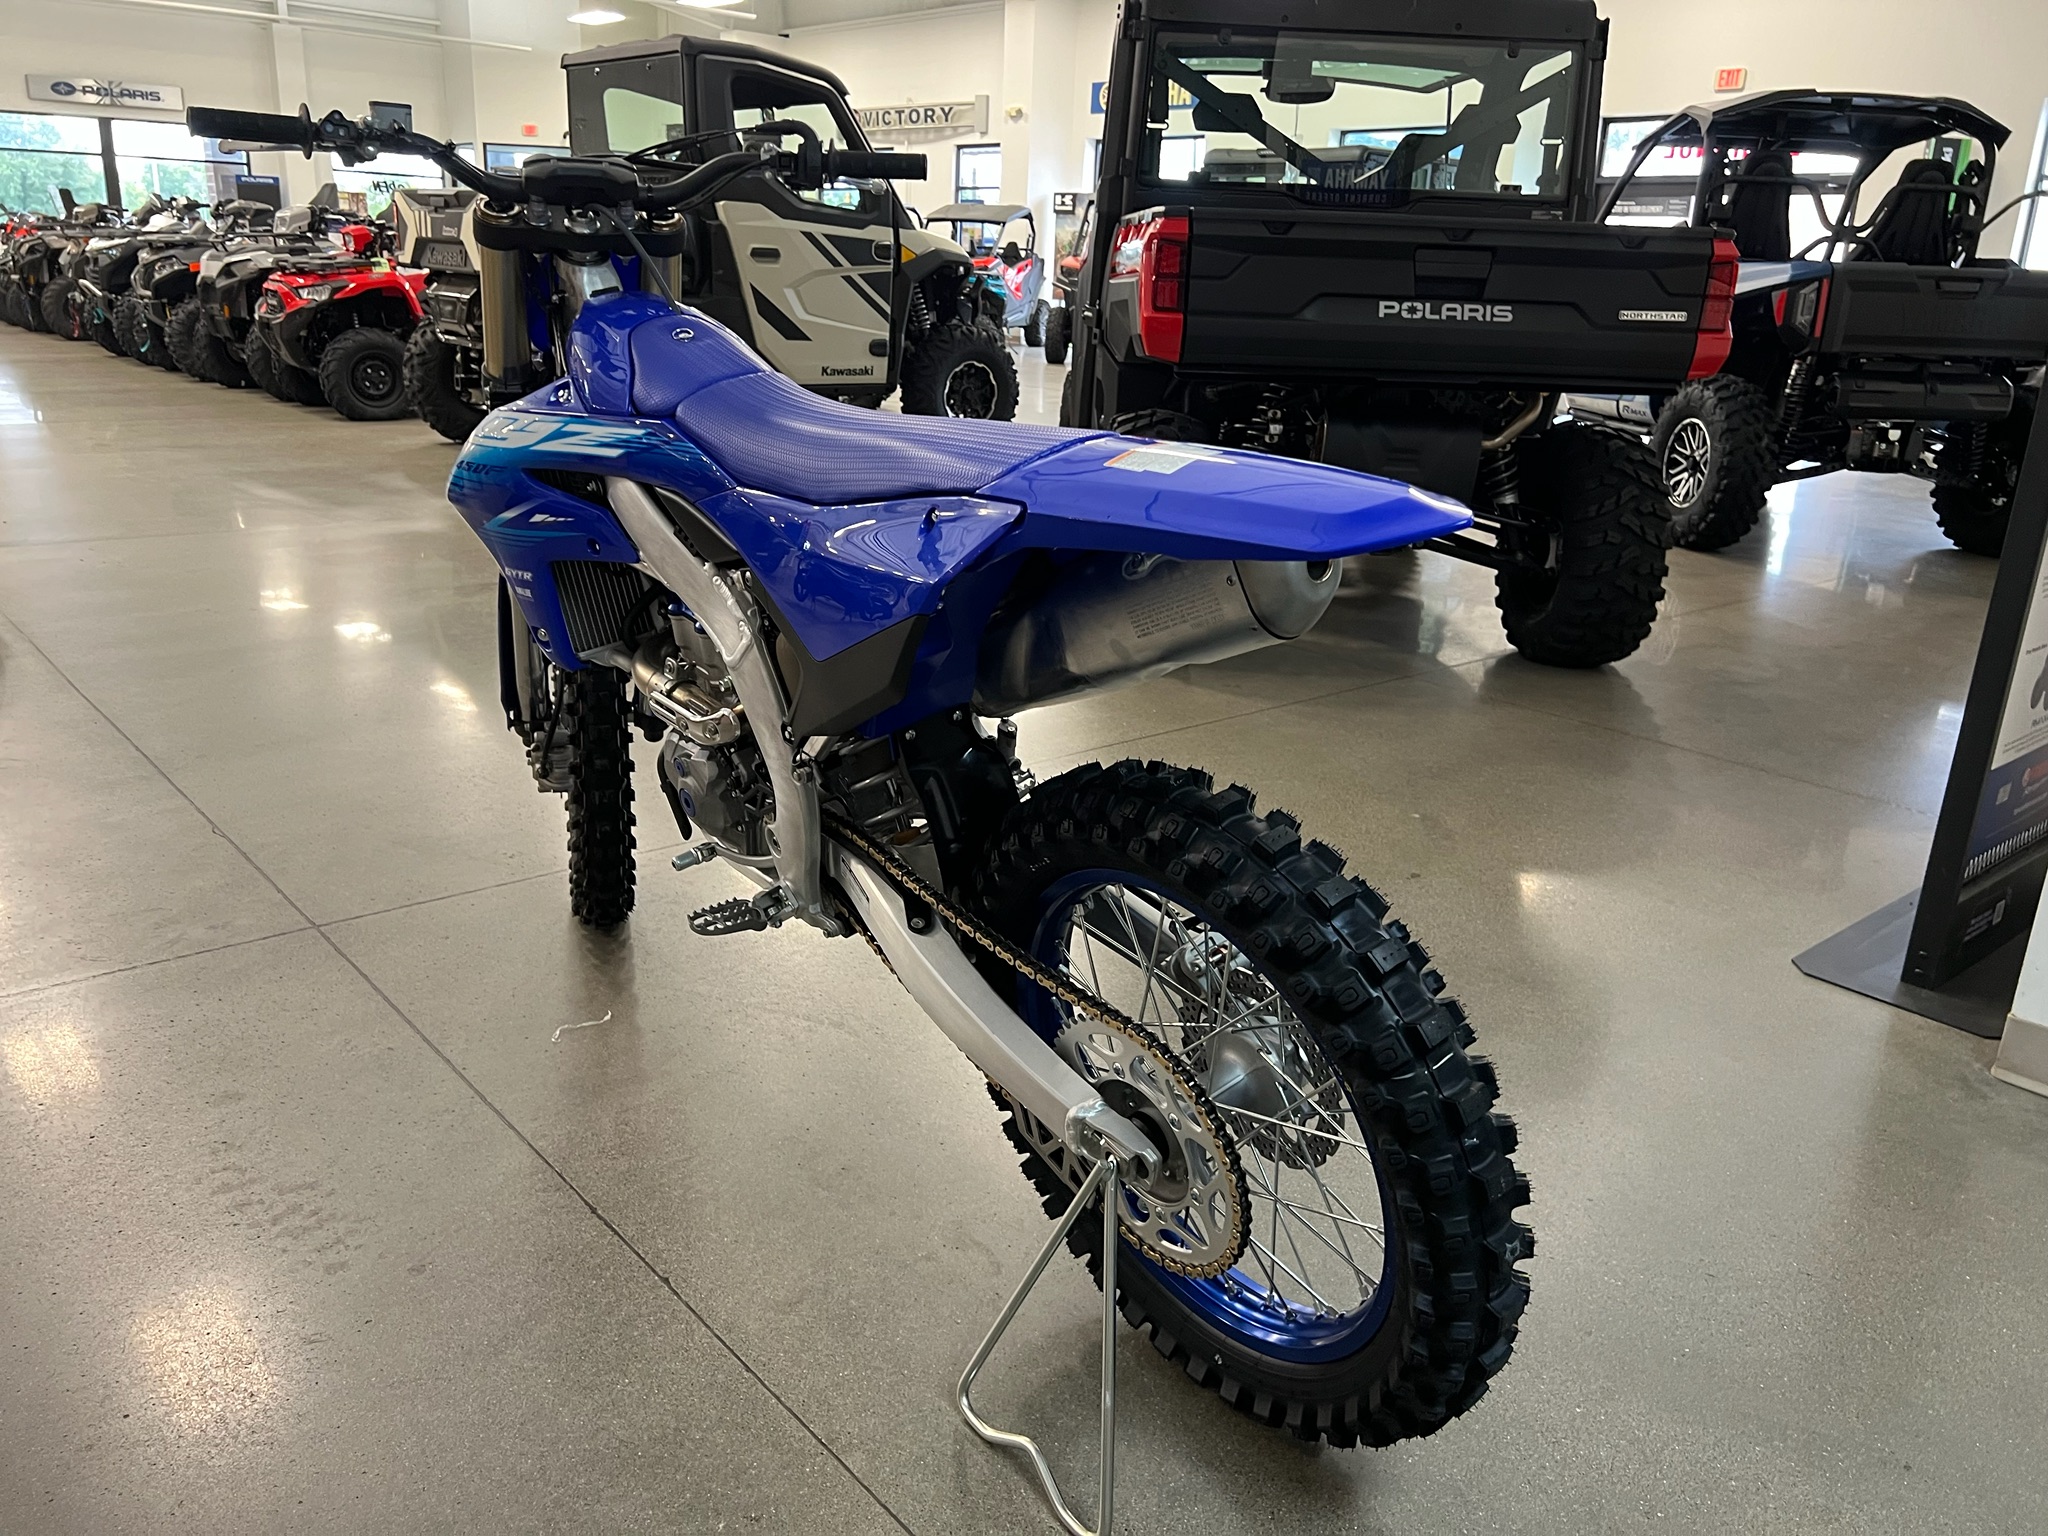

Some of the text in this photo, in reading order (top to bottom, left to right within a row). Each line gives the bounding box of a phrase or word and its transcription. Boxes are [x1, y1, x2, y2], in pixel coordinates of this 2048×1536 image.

[1718, 69, 1742, 88] EXIT
[82, 86, 161, 102] POLARIS
[864, 106, 954, 127] VICTORY
[1378, 301, 1514, 322] POLARIS
[1621, 312, 1684, 320] NORTHSTAR
[821, 365, 874, 377] Kawasaki
